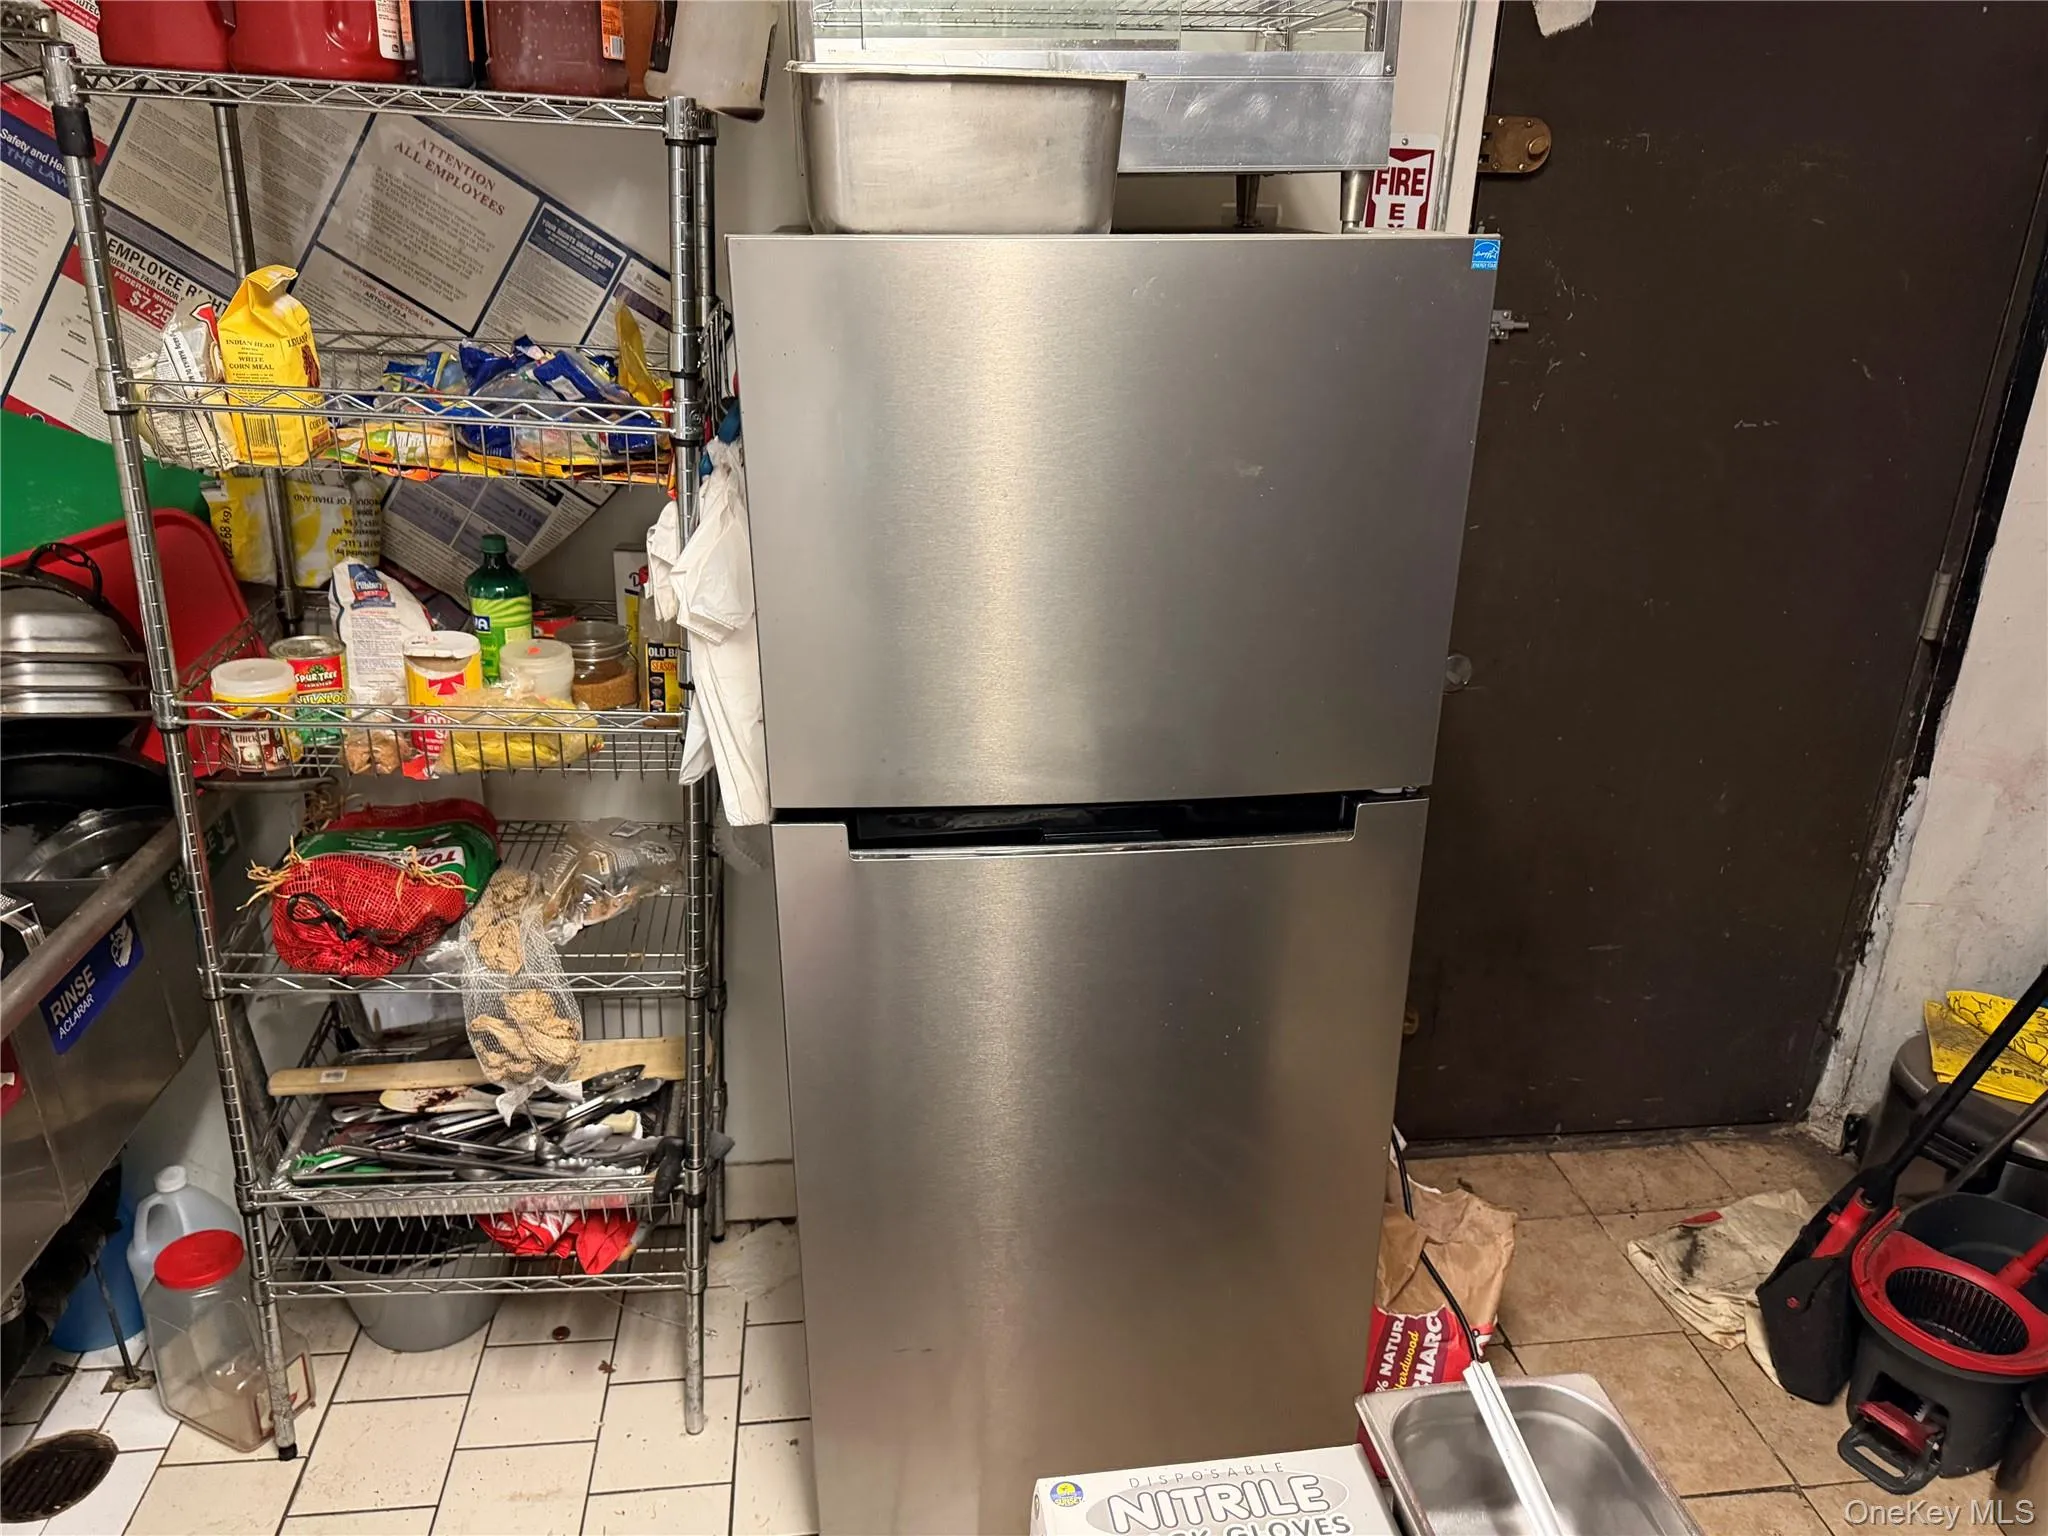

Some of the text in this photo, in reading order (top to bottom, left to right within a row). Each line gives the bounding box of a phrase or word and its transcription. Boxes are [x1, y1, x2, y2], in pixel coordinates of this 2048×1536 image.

[0, 128, 31, 153] Safety
[30, 147, 50, 163] and
[7, 145, 34, 169] THE
[394, 142, 505, 216] ALL EMPLOYEES
[418, 137, 496, 192] ATTENTION
[1375, 167, 1426, 197] FIRE
[107, 238, 184, 292] EMPLOYEE
[114, 270, 150, 295] FEDERAL
[127, 266, 140, 277] THE
[140, 272, 156, 287] FAIR
[157, 284, 180, 301] LABOR
[130, 290, 172, 323] $7.25
[226, 339, 253, 348] INDIAN
[648, 647, 666, 658] OLD
[295, 672, 317, 683] SPUR
[49, 964, 96, 1026] RINSE
[59, 993, 94, 1040] ACLARAR
[1129, 1462, 1284, 1488] DISPOSABLE
[1107, 1474, 1331, 1534] NITRILE
